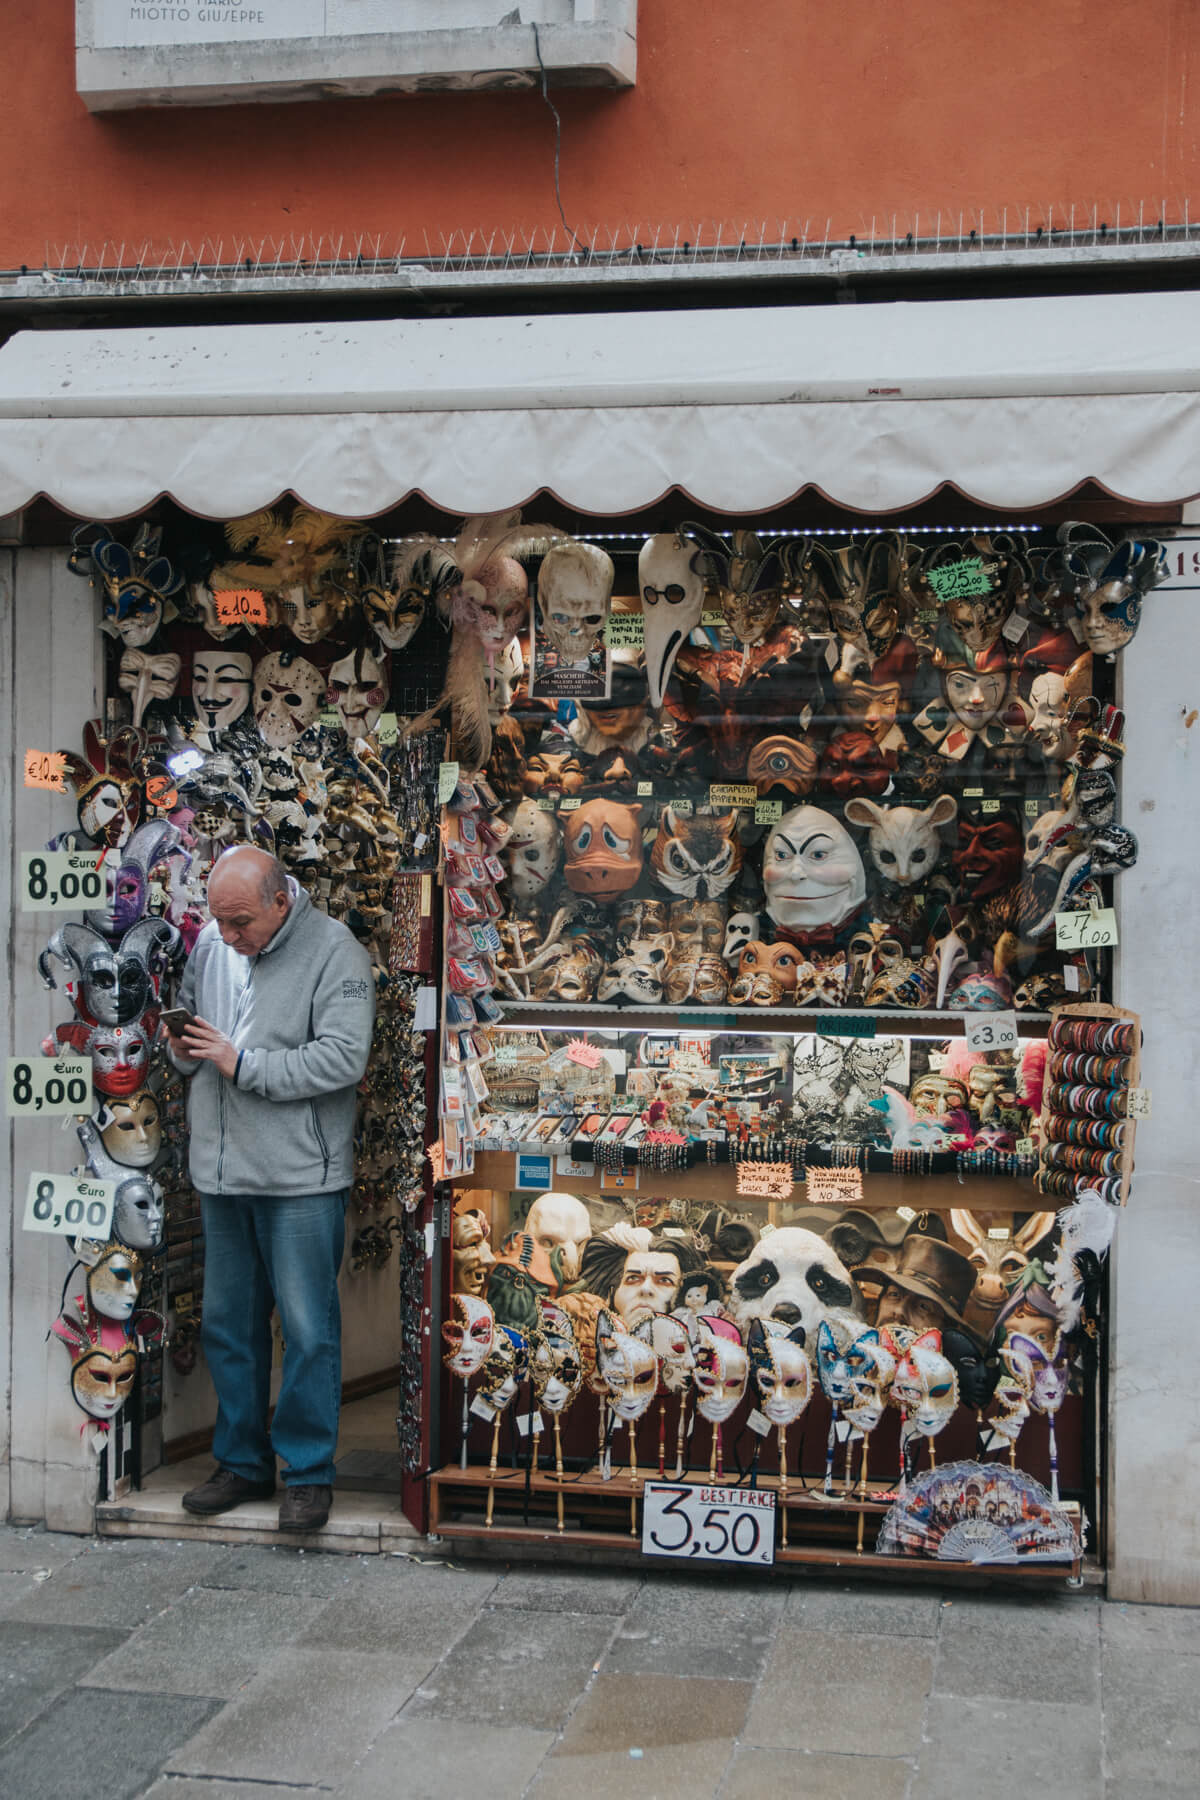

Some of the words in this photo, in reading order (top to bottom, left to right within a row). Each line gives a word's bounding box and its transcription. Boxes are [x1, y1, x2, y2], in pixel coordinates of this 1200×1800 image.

[130, 7, 190, 21] MIOTTO
[197, 9, 264, 23] GIUSEPPE
[28, 858, 102, 906] 8,00
[13, 1063, 87, 1110] 8,00
[33, 1179, 107, 1228] 8,00
[820, 1191, 834, 1200] NO
[650, 1486, 760, 1557] 3,50
[700, 1488, 737, 1503] BEST
[739, 1490, 777, 1508] PRICE
